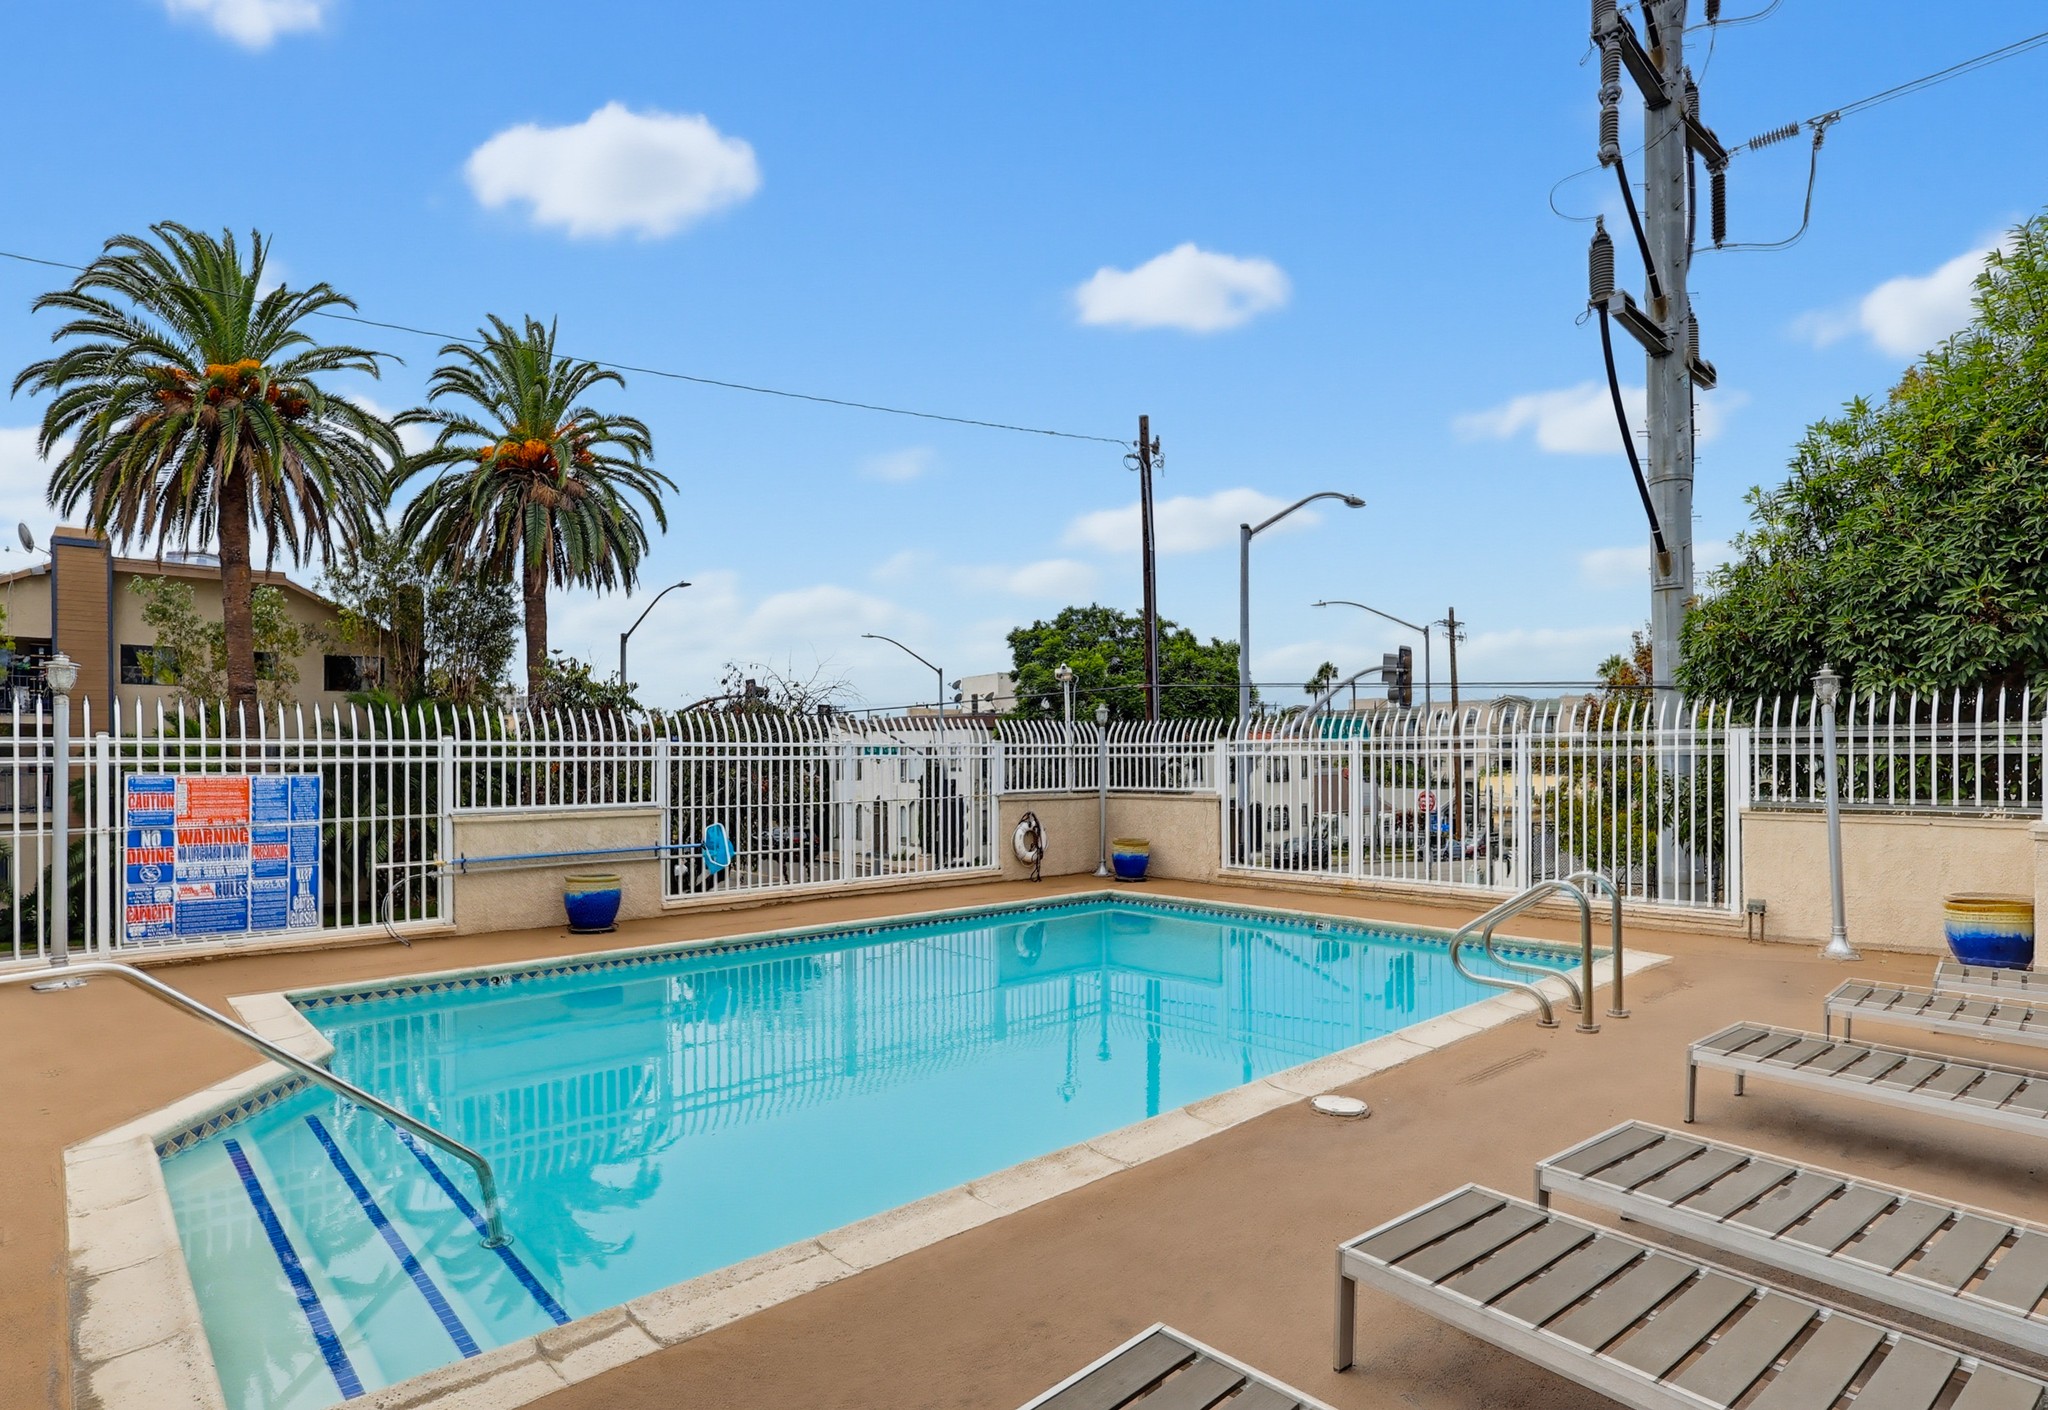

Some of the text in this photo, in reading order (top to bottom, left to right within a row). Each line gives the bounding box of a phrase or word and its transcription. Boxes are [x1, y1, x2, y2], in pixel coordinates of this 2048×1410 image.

[128, 793, 174, 810] CAUTION
[141, 830, 161, 848] NO
[178, 828, 249, 845] WARNING
[127, 848, 174, 865] DIVING
[215, 881, 249, 898] RULES
[126, 905, 172, 923] CAPACITY
